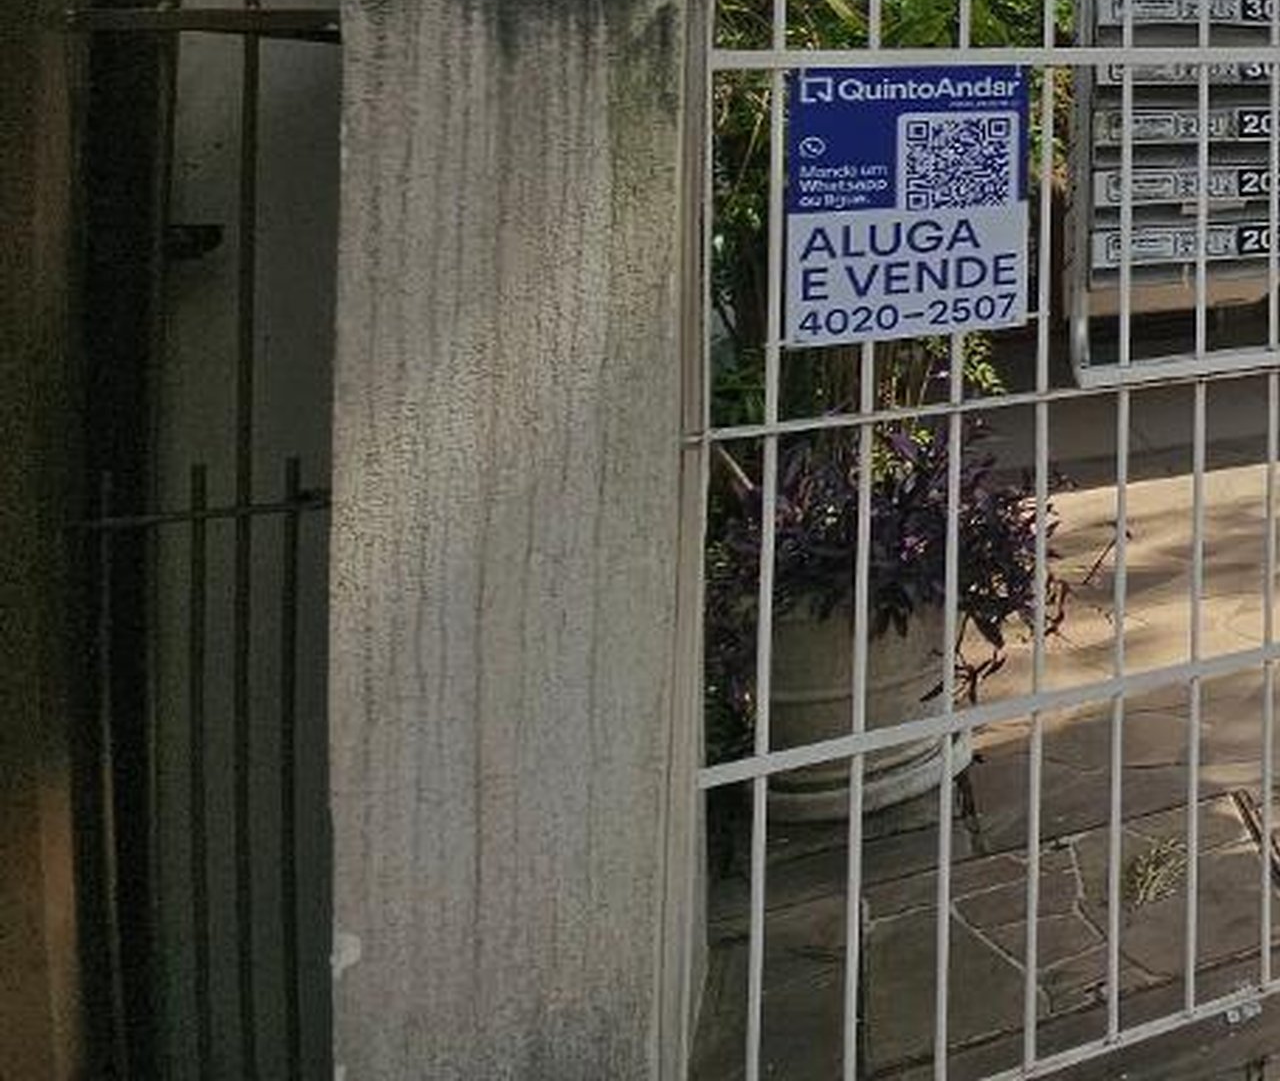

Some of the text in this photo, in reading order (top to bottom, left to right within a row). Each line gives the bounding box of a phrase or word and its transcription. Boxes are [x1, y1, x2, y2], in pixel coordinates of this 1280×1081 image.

[838, 77, 1018, 101] QuintoAndar
[800, 219, 981, 262] ALUGA
[802, 253, 1018, 301] E VENDE
[799, 293, 1017, 336] 4020-2507
